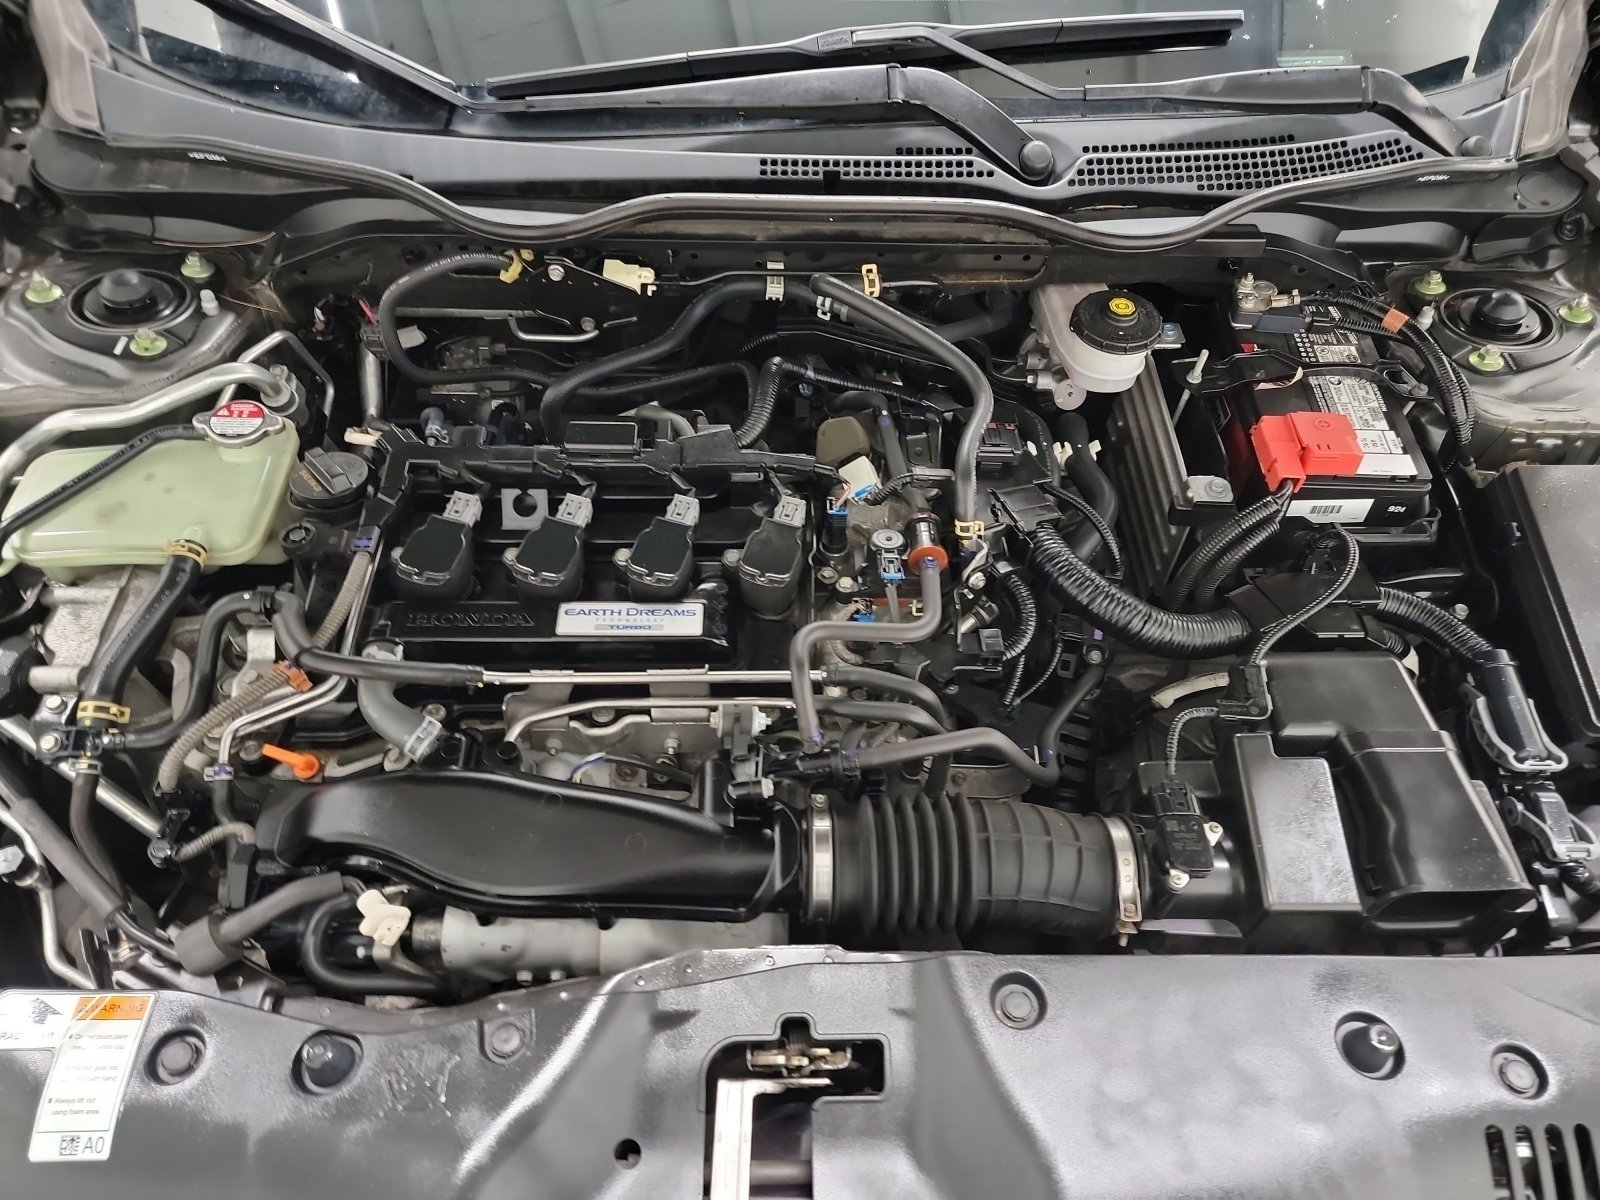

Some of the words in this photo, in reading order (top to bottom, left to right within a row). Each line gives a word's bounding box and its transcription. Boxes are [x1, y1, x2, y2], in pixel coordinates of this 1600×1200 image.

[564, 608, 622, 616] EARTH
[626, 607, 697, 616] DREAMS
[406, 612, 535, 627] HONDA
[82, 1137, 104, 1153] A0
